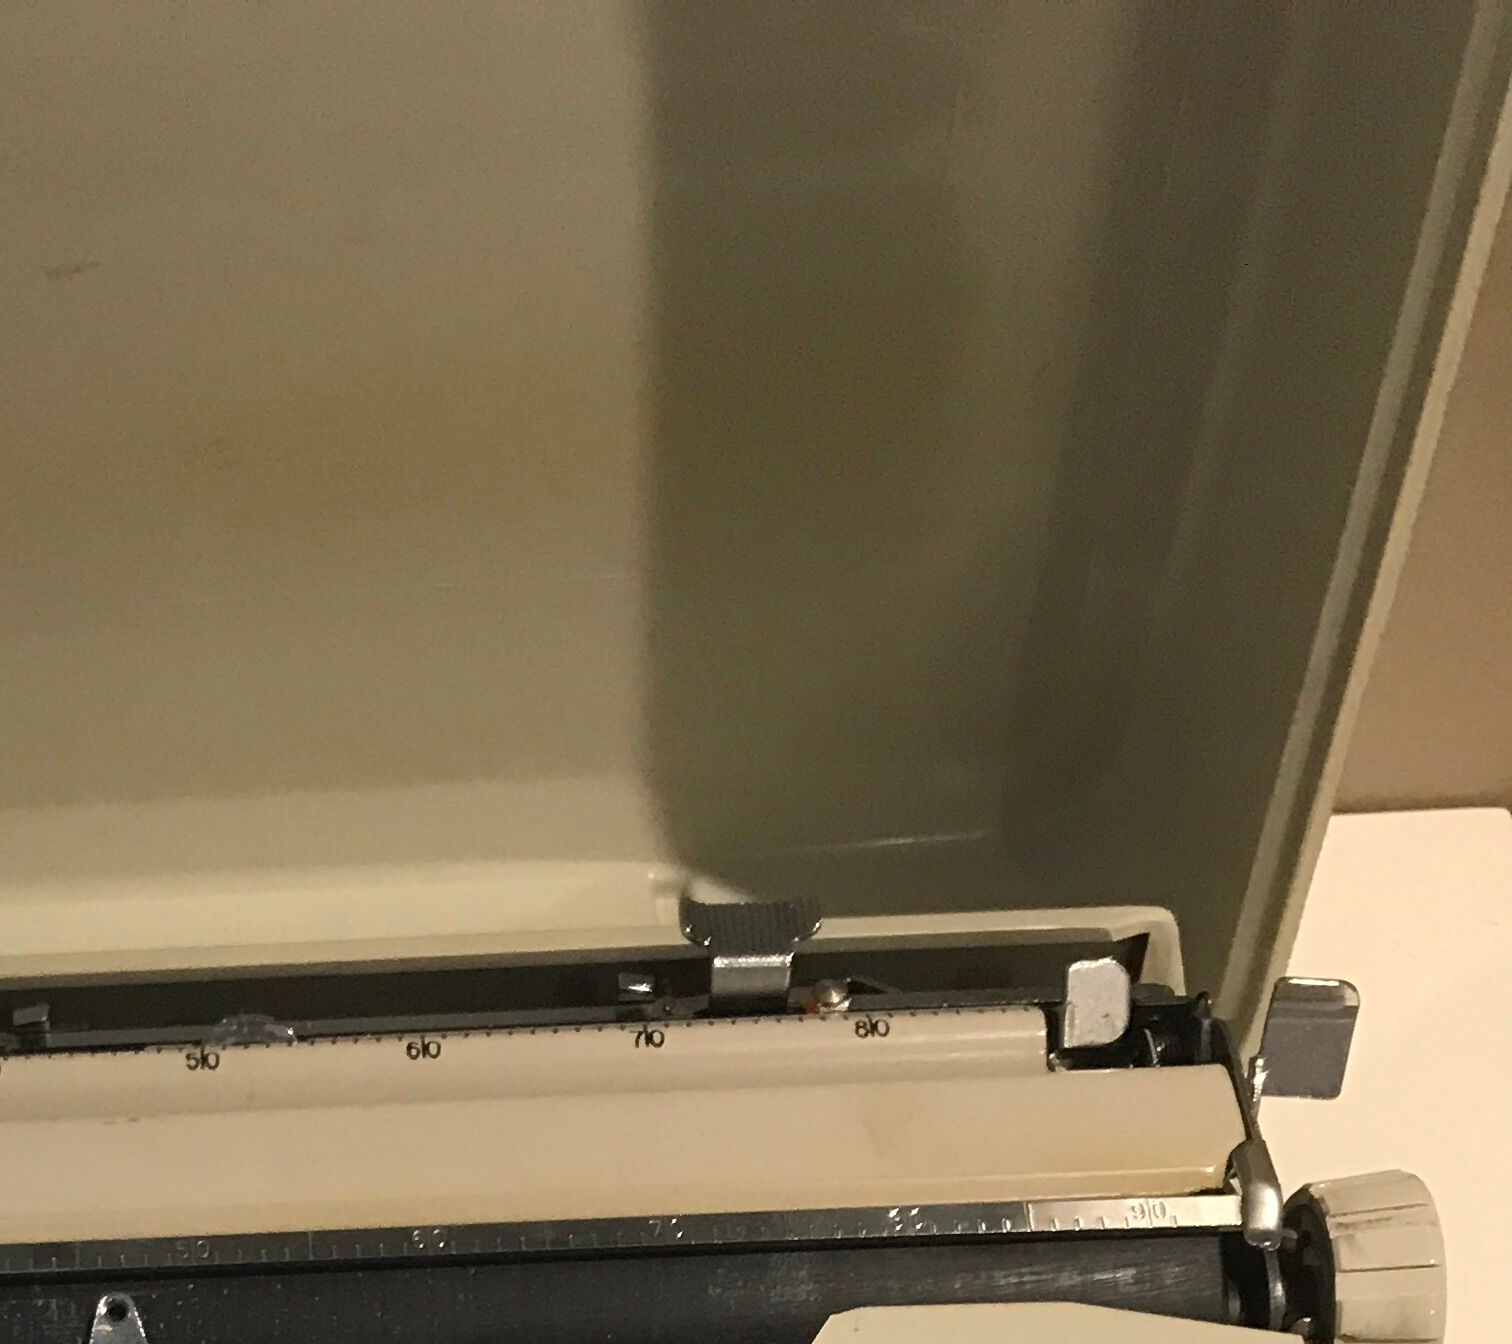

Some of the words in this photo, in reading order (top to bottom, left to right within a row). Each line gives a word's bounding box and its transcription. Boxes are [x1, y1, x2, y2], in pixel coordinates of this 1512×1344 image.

[186, 1050, 220, 1071] 50
[406, 1039, 442, 1060] 60
[631, 1029, 665, 1048] 70
[855, 1019, 890, 1038] 80
